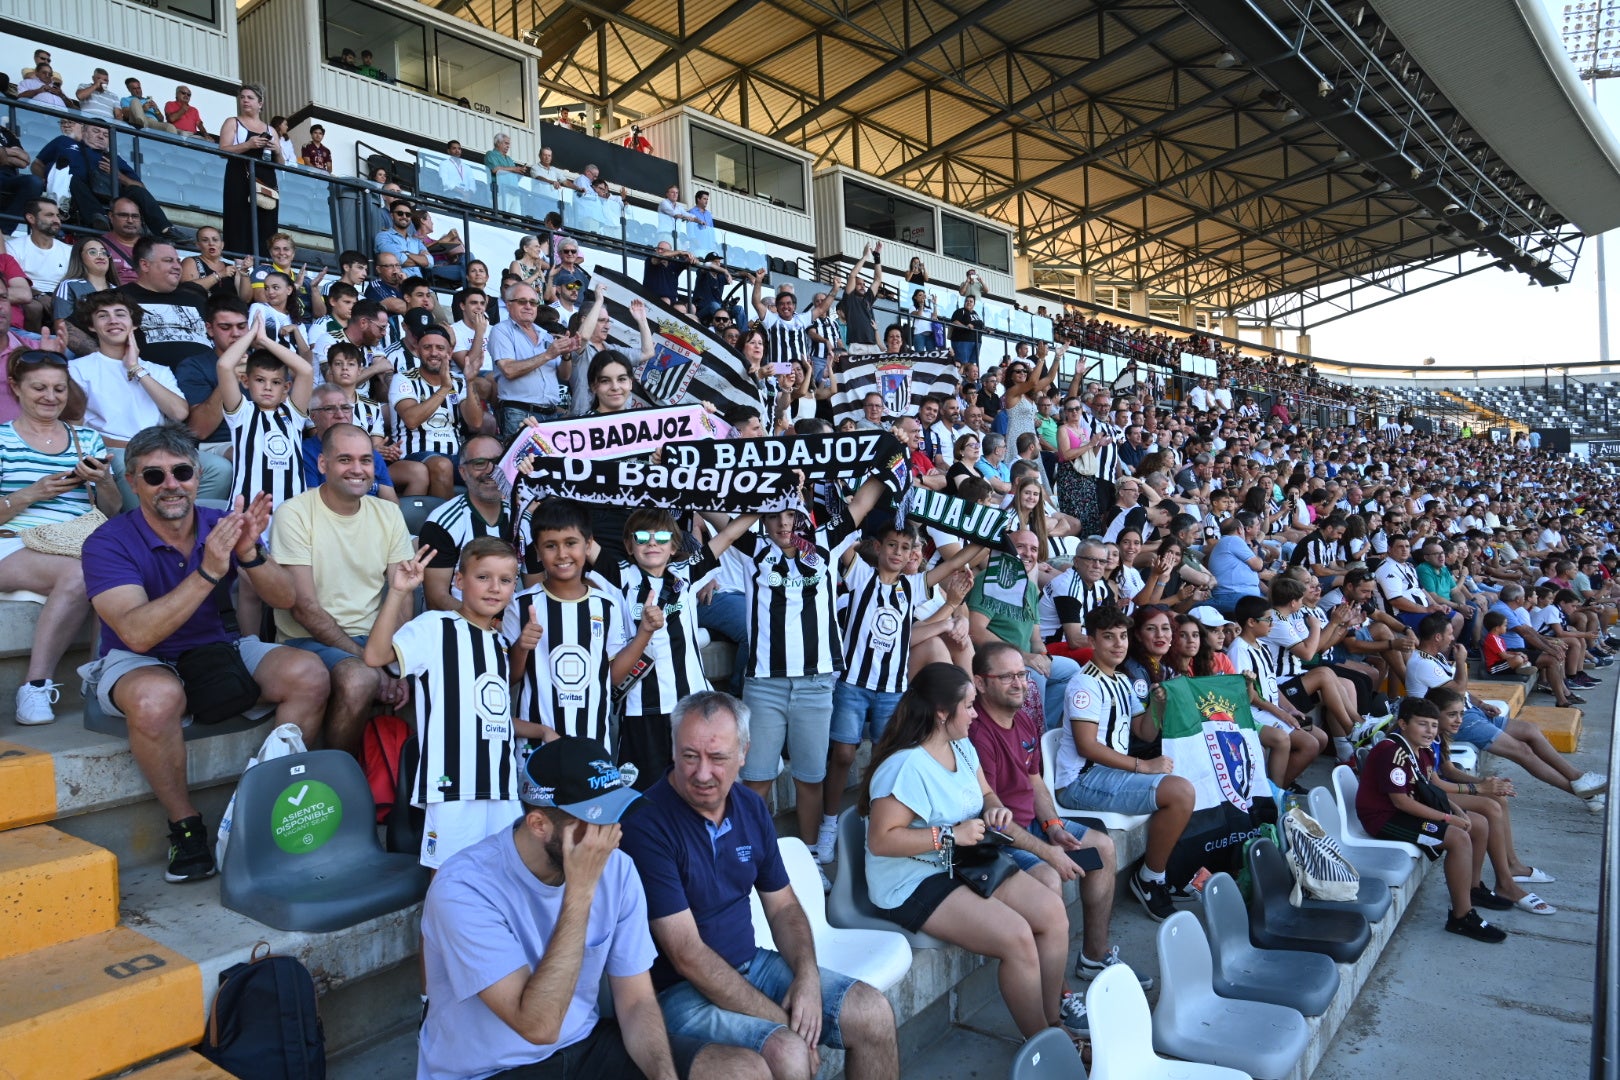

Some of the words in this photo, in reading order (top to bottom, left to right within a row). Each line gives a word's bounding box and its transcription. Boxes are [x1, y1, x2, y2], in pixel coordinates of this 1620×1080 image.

[474, 102, 491, 114] CDB
[664, 340, 691, 357] CLUB
[669, 362, 700, 405] BADAJOZ
[551, 430, 585, 453] CD
[589, 415, 693, 451] BADAJOZ
[713, 434, 881, 470] BADAJOZ
[618, 461, 782, 498] Badajoz
[559, 692, 583, 701] Civitas
[485, 724, 507, 734] Civitas
[276, 806, 335, 835] DISPONIBLE
[282, 802, 325, 824] ASIENTO
[283, 822, 310, 837] VACANT
[311, 815, 329, 826] SEAT
[1205, 838, 1228, 852] CLUB
